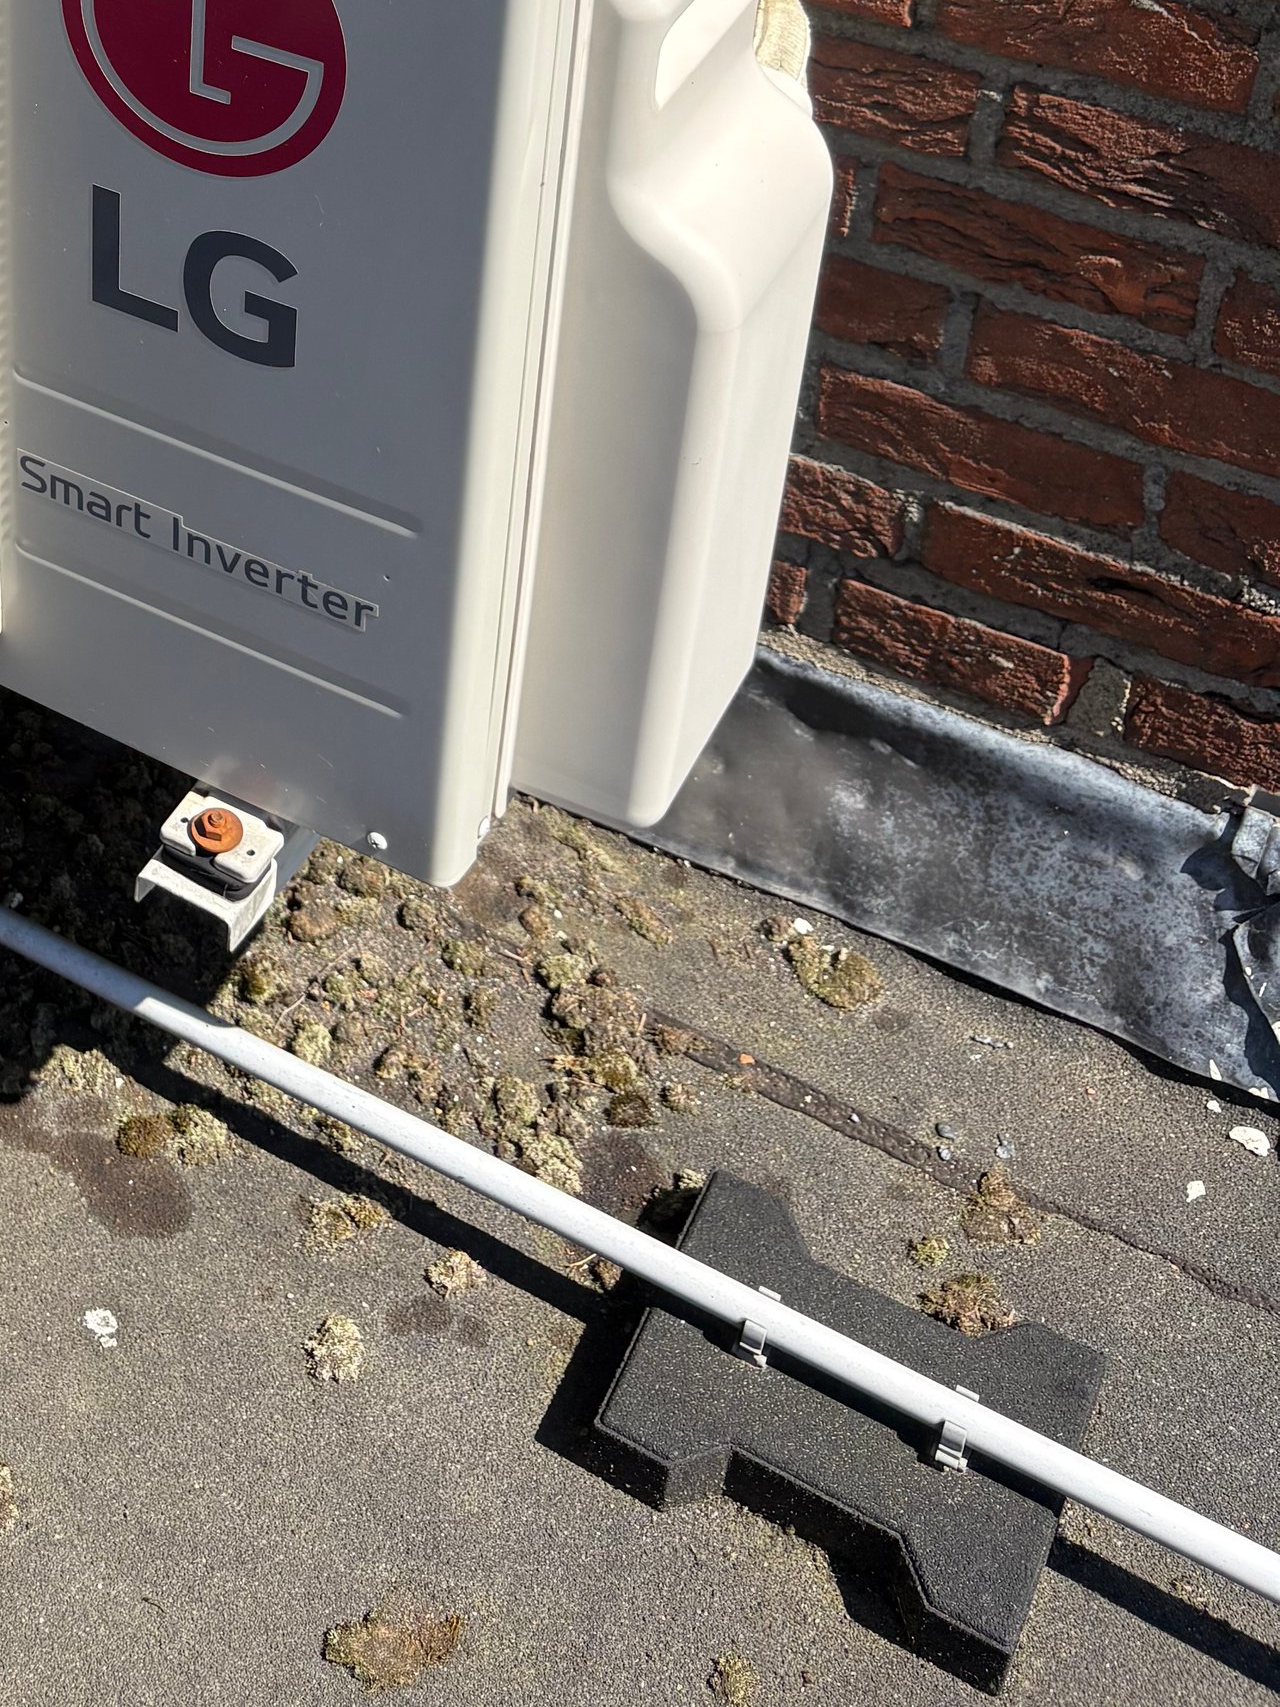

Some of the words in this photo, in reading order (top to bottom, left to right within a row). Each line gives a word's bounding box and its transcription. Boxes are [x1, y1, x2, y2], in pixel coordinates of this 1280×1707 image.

[92, 182, 298, 368] LG
[19, 454, 152, 539] Smart
[171, 515, 374, 627] Inverter
